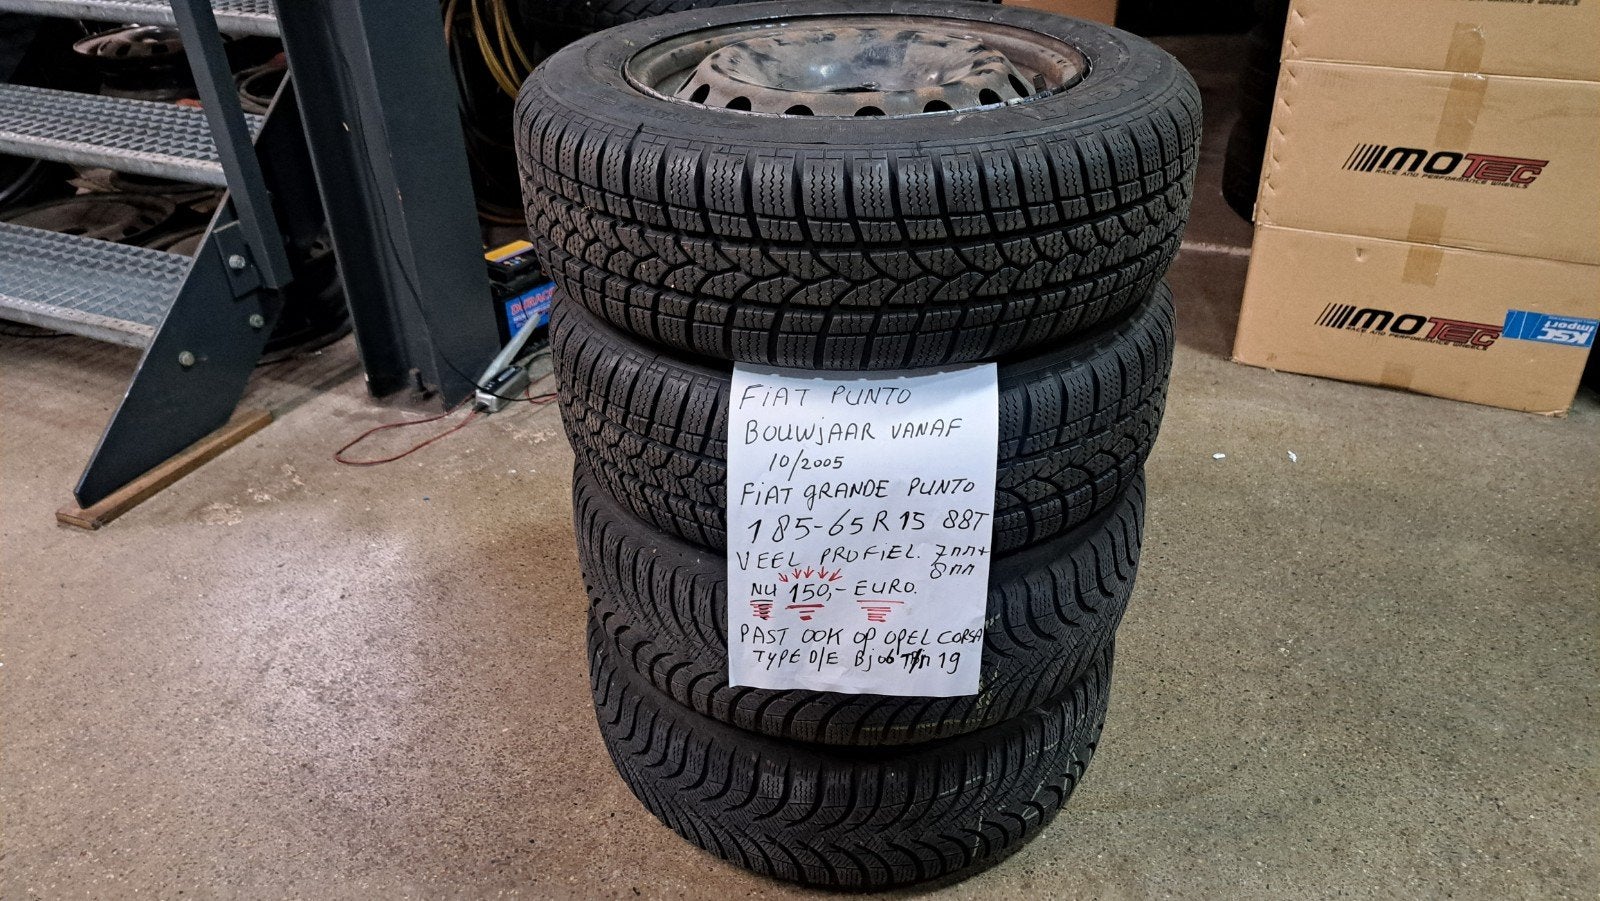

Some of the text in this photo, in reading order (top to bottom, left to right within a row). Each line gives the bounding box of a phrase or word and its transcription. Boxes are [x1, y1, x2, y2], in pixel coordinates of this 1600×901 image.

[1422, 173, 1487, 185] PERFORMANCE
[1490, 181, 1528, 189] WHEELS
[1389, 333, 1450, 346] PERFORMANCE
[831, 385, 911, 406] PUNTO
[891, 418, 962, 439] VANAF
[769, 449, 845, 481] 10/2005
[908, 477, 975, 496] PUNTO
[943, 508, 990, 531] 88T
[737, 551, 801, 570] VEEL
[751, 583, 776, 597] NU
[854, 580, 917, 597] EURO.
[741, 623, 789, 646] PAST
[801, 628, 844, 645] OOK
[884, 628, 931, 655] OPEL
[937, 628, 983, 644] CORSA
[809, 647, 839, 671] D/E
[939, 651, 960, 674] 19
